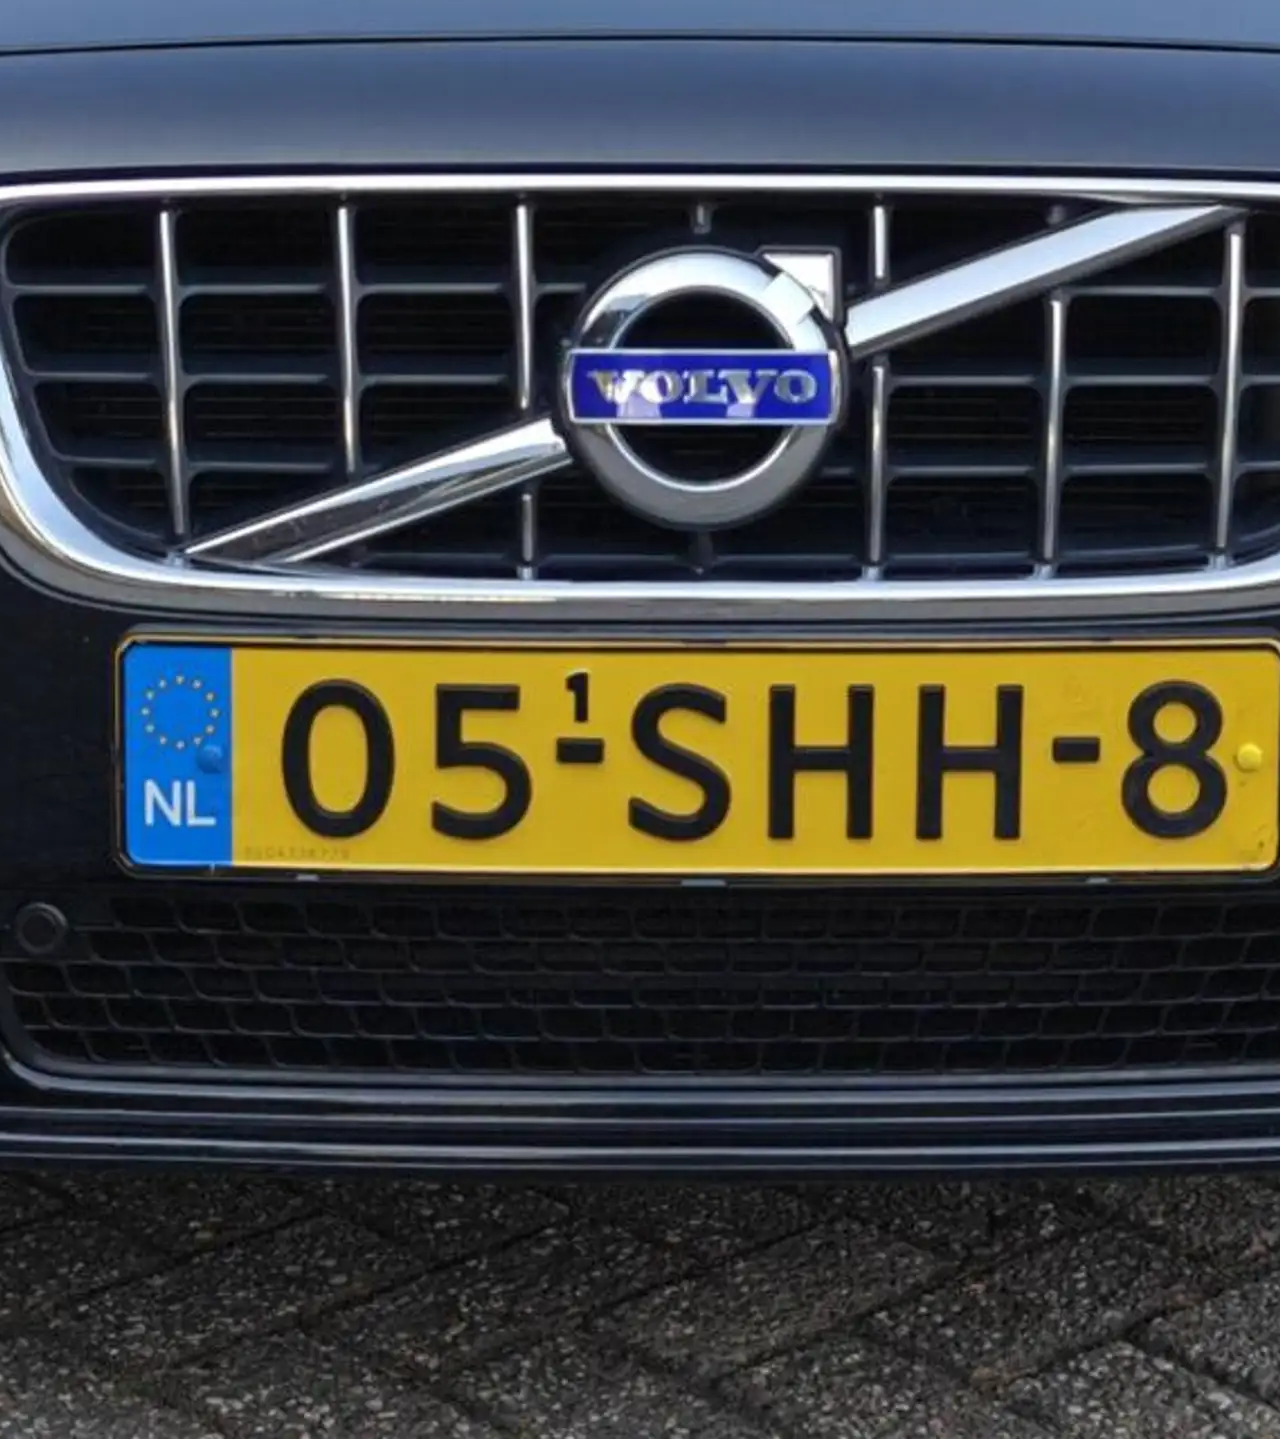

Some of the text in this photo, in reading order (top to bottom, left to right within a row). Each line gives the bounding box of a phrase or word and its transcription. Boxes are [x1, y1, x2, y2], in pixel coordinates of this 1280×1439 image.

[587, 369, 818, 405] VOLVO
[281, 678, 1228, 842] 05-SHH-8
[144, 779, 217, 827] NL
